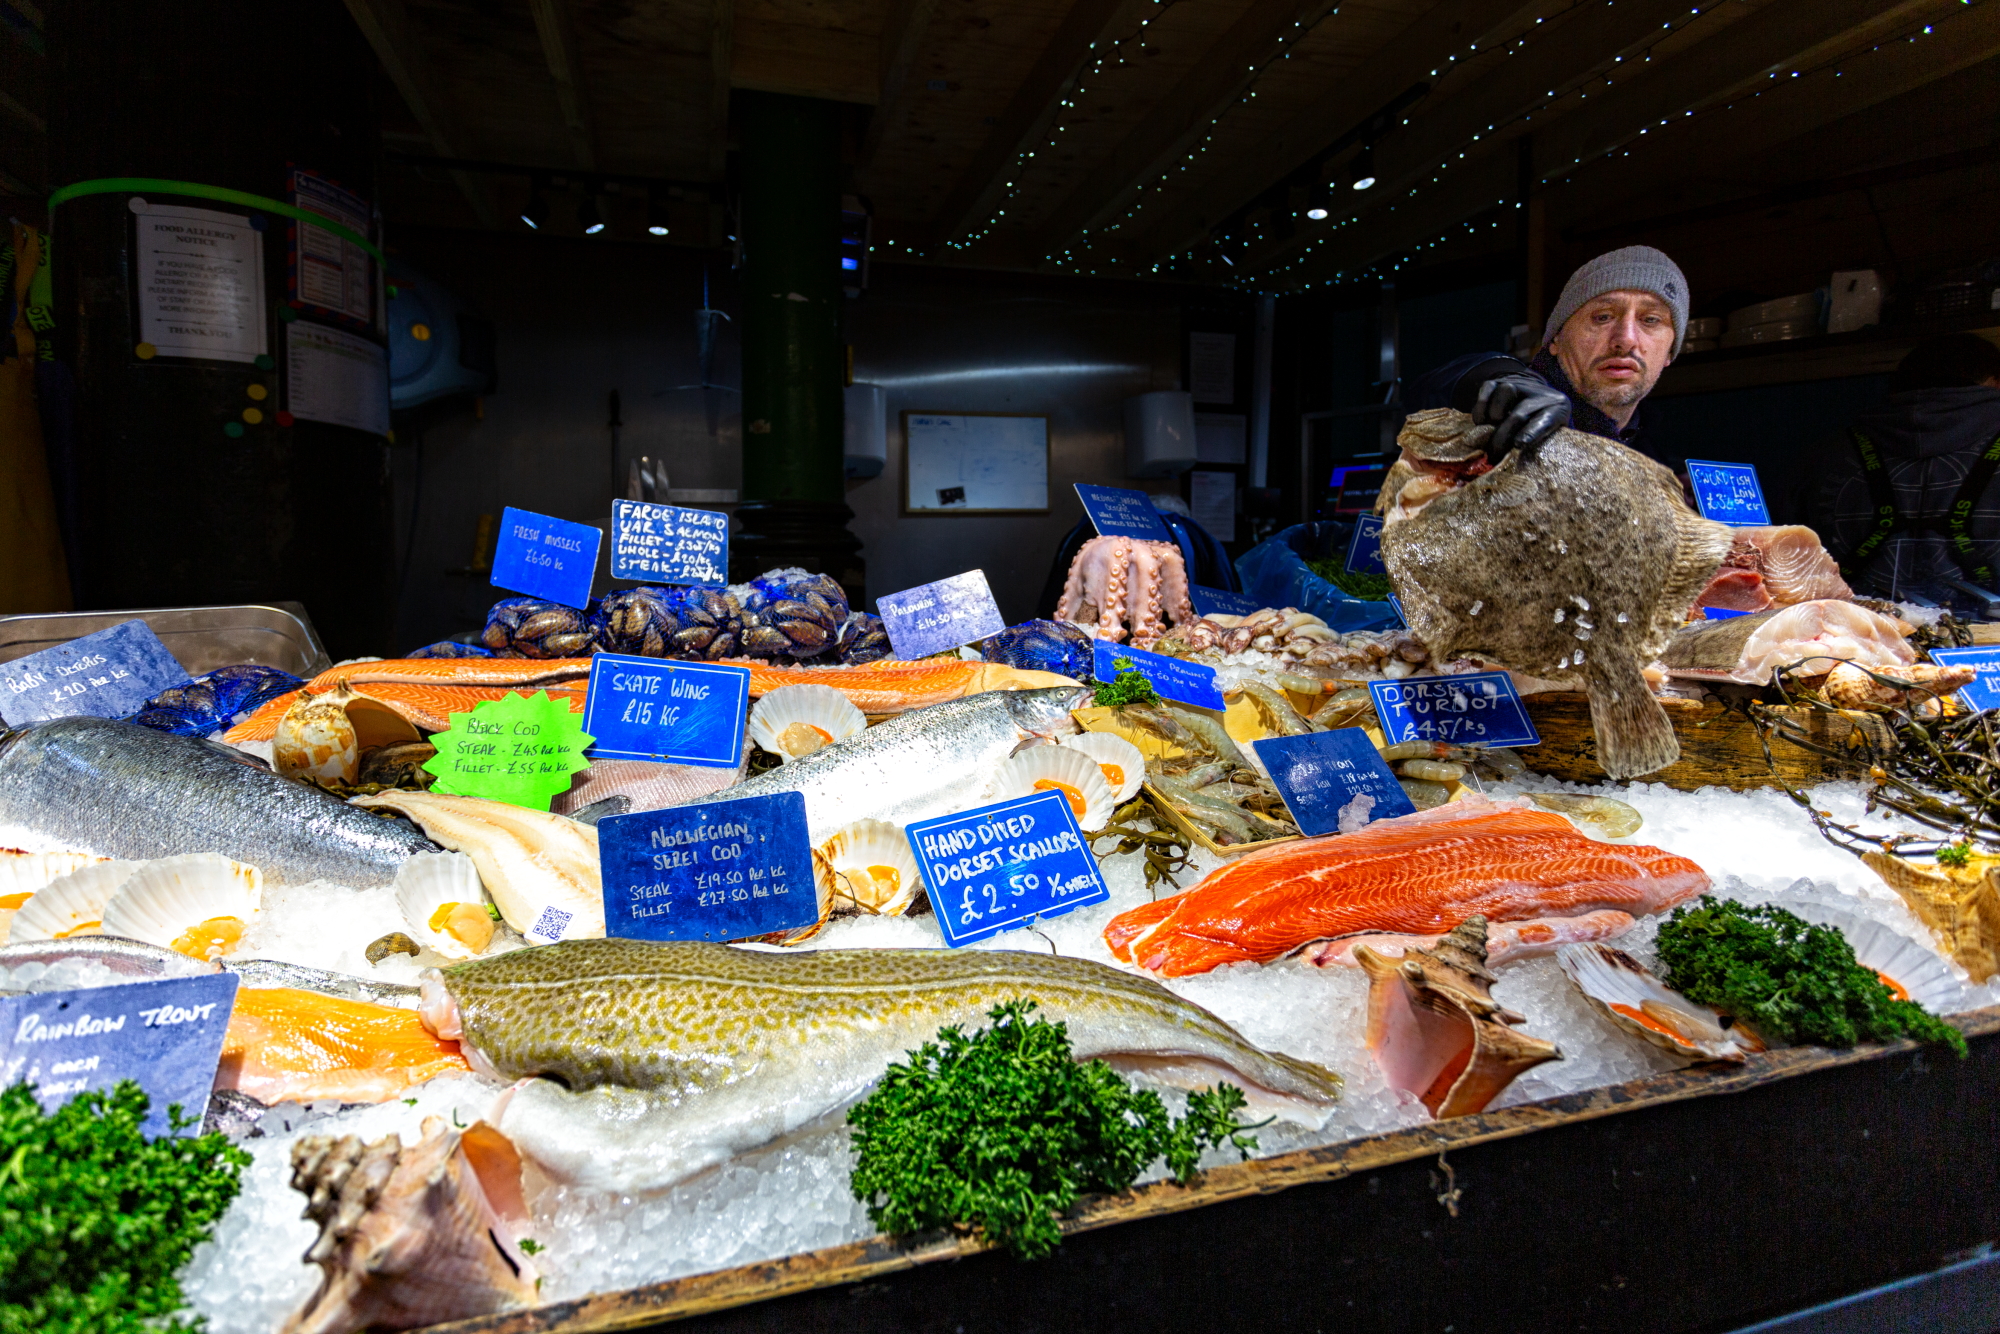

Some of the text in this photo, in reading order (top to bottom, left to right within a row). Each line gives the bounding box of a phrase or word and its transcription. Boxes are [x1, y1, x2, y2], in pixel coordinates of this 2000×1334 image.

[154, 224, 238, 241] FOOD ALLERGY
[176, 235, 218, 248] NOTICE
[169, 326, 233, 341] THANK YOU
[1732, 486, 1756, 501] LOIN
[619, 503, 672, 522] FAROE
[513, 524, 583, 554] FRESH MUSSELS
[618, 532, 665, 547] FILLET
[617, 545, 661, 559] WHOLE
[618, 557, 673, 574] STEAK
[889, 597, 936, 618] PALOURDE
[916, 614, 952, 631] £16.50
[56, 654, 108, 677] OCTOPUS
[612, 673, 711, 701] SKATE WING
[1382, 682, 1483, 702] DORSET
[621, 698, 680, 727] £15 KG
[1391, 694, 1509, 718] TURBOT
[466, 718, 541, 736] BLACK COD
[457, 741, 497, 757] STEAK
[512, 743, 538, 758] £45
[454, 758, 495, 774] FILLET
[507, 761, 536, 775] £55
[651, 822, 749, 849] NORWEGIAN
[923, 814, 1036, 860] HAND DIVED
[652, 843, 742, 871] SKREI COD
[933, 831, 1081, 887] DORSET SCALLOPS
[629, 881, 673, 902] STEAK
[695, 870, 744, 890] £19.50
[631, 901, 674, 919] FILLET
[697, 890, 749, 907] £27.50
[960, 873, 1040, 926] £2.50
[15, 1002, 218, 1044] RAINBOW TROUT
